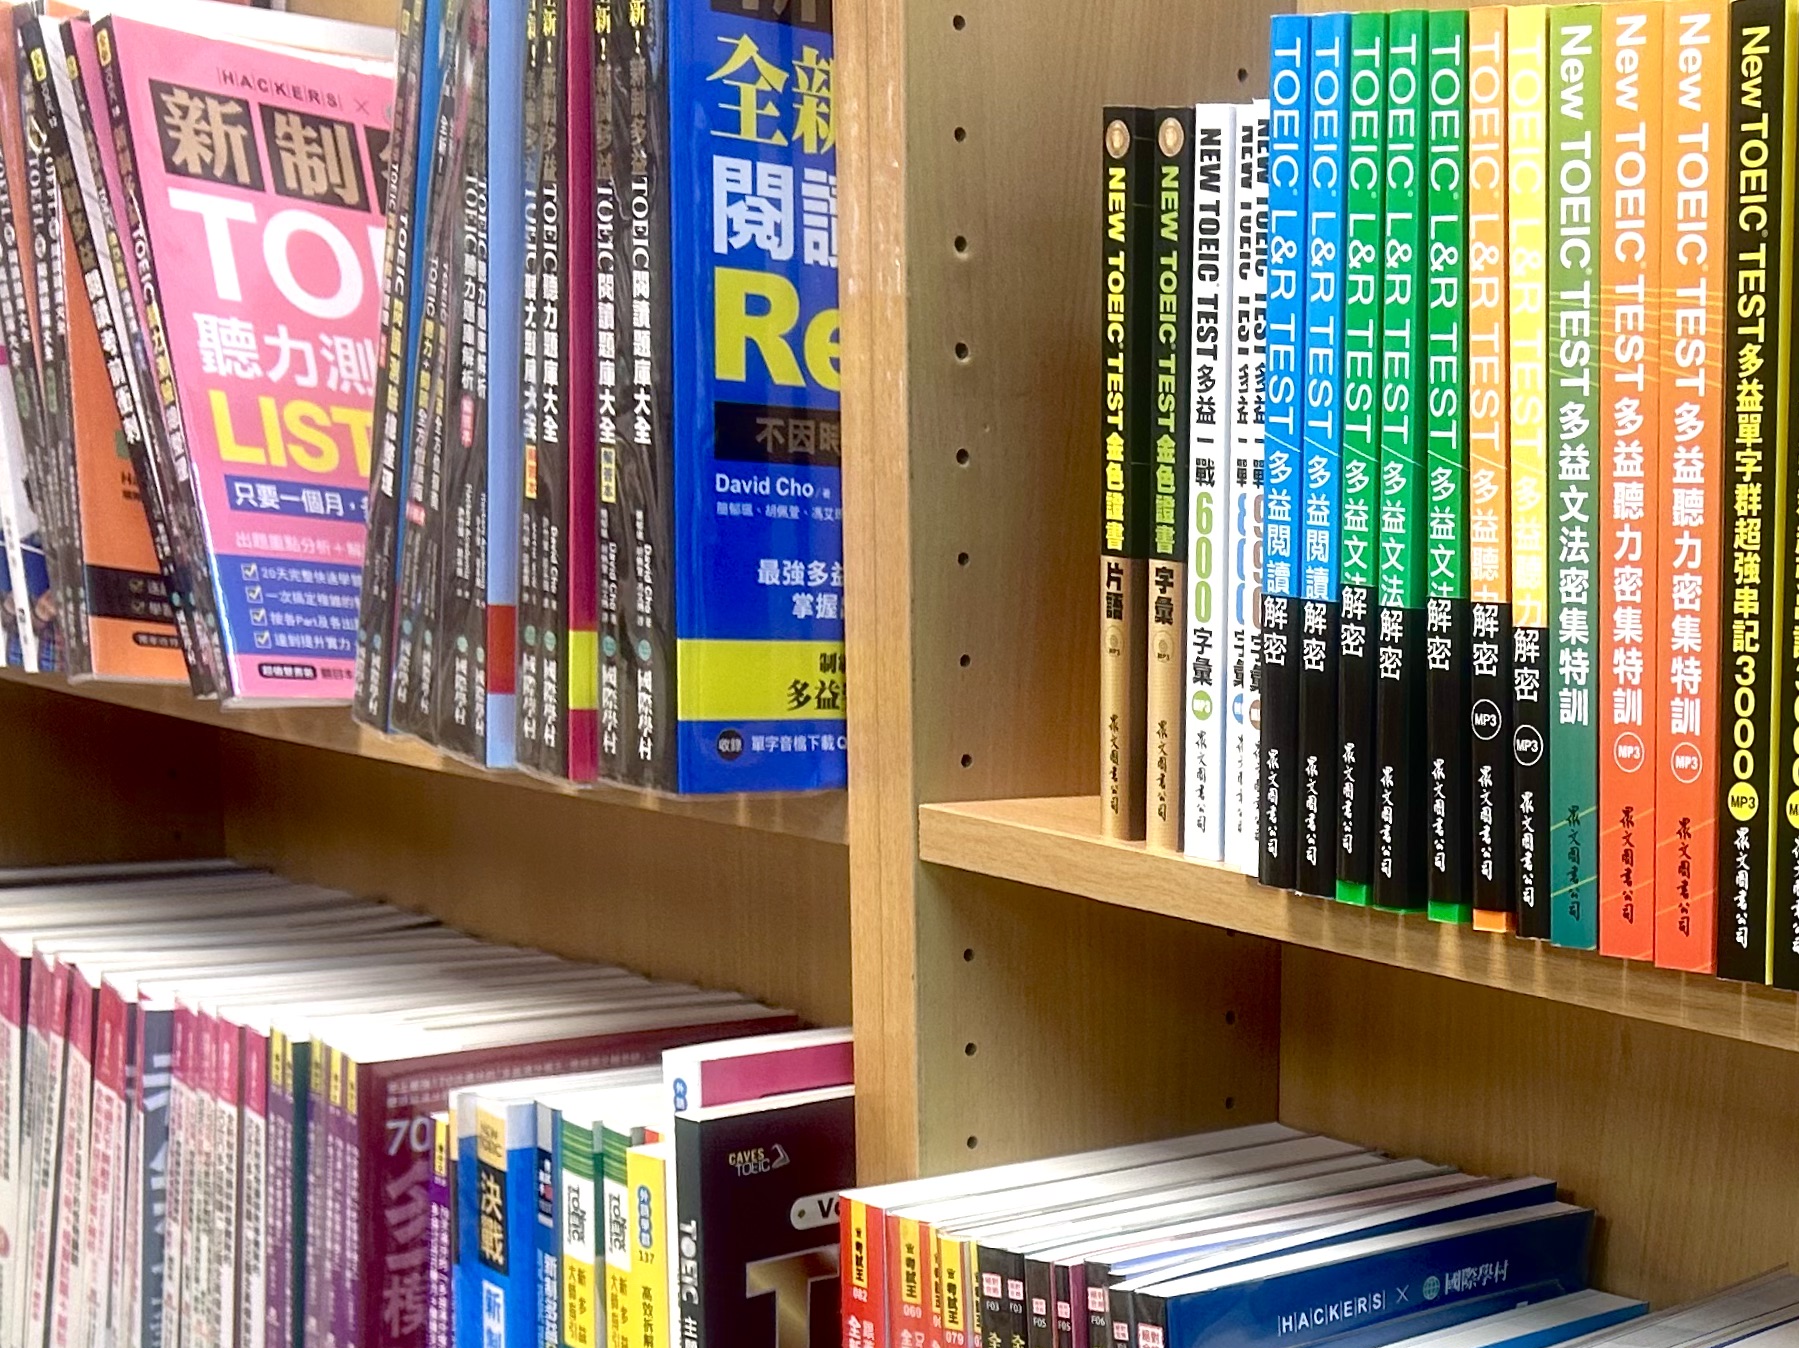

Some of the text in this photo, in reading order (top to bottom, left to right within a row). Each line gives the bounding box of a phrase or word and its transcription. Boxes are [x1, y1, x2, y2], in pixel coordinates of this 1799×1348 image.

[1741, 25, 1770, 108] New
[1272, 36, 1302, 190] TOEIC
[1107, 167, 1127, 243] NEW
[1738, 117, 1768, 233] TOEIC
[1106, 252, 1125, 344] TOEIC
[1269, 211, 1297, 302] L&R
[1736, 250, 1766, 342] TEST
[1105, 352, 1124, 429] TEST
[1265, 317, 1295, 435] TEST
[1556, 24, 1592, 726] New TOEIC TEST 多益文法密集特訓
[1612, 13, 1646, 726] New TOEIC TEST 多益聽力密集特訓
[715, 473, 814, 496] David Cho
[1618, 744, 1640, 761] MP3
[728, 1149, 764, 1165] CAVES
